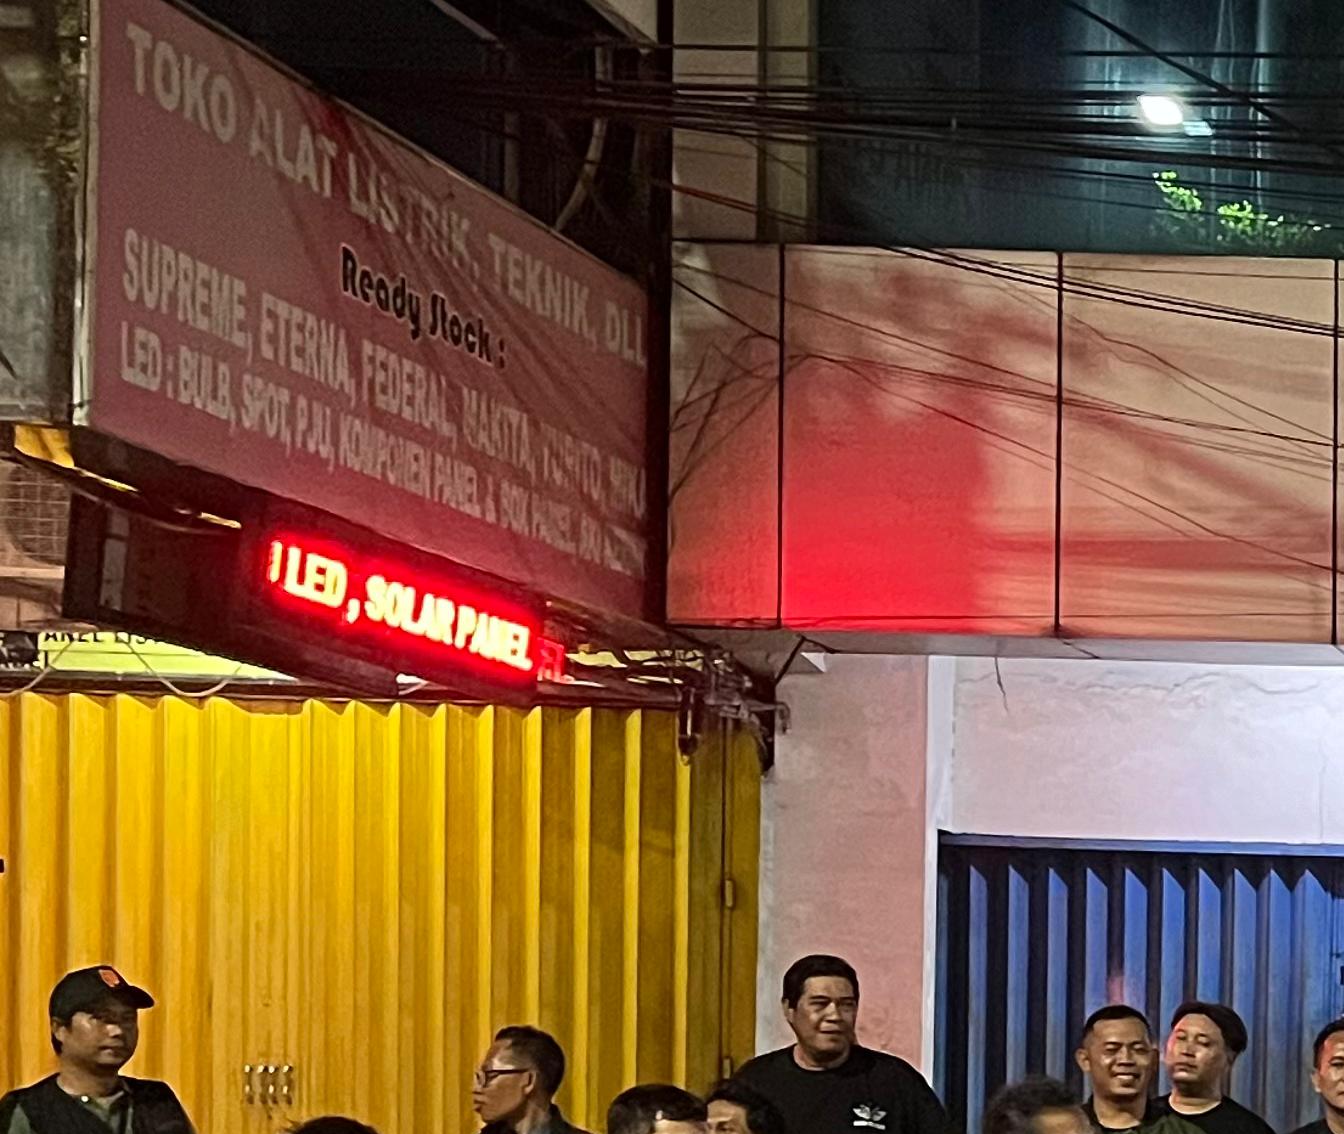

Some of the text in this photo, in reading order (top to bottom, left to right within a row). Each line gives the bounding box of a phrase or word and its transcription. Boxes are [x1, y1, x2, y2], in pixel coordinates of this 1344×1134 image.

[126, 22, 237, 144] TOKO
[250, 98, 338, 198] ALAT
[123, 227, 253, 366] SUPREME,
[260, 292, 356, 407] ETERNA,
[340, 243, 422, 341] Ready
[429, 290, 493, 367] Stock
[121, 320, 162, 392] LED
[178, 344, 237, 436] BULB,
[365, 575, 455, 646] SOLAR
[455, 605, 533, 671] PANEL
